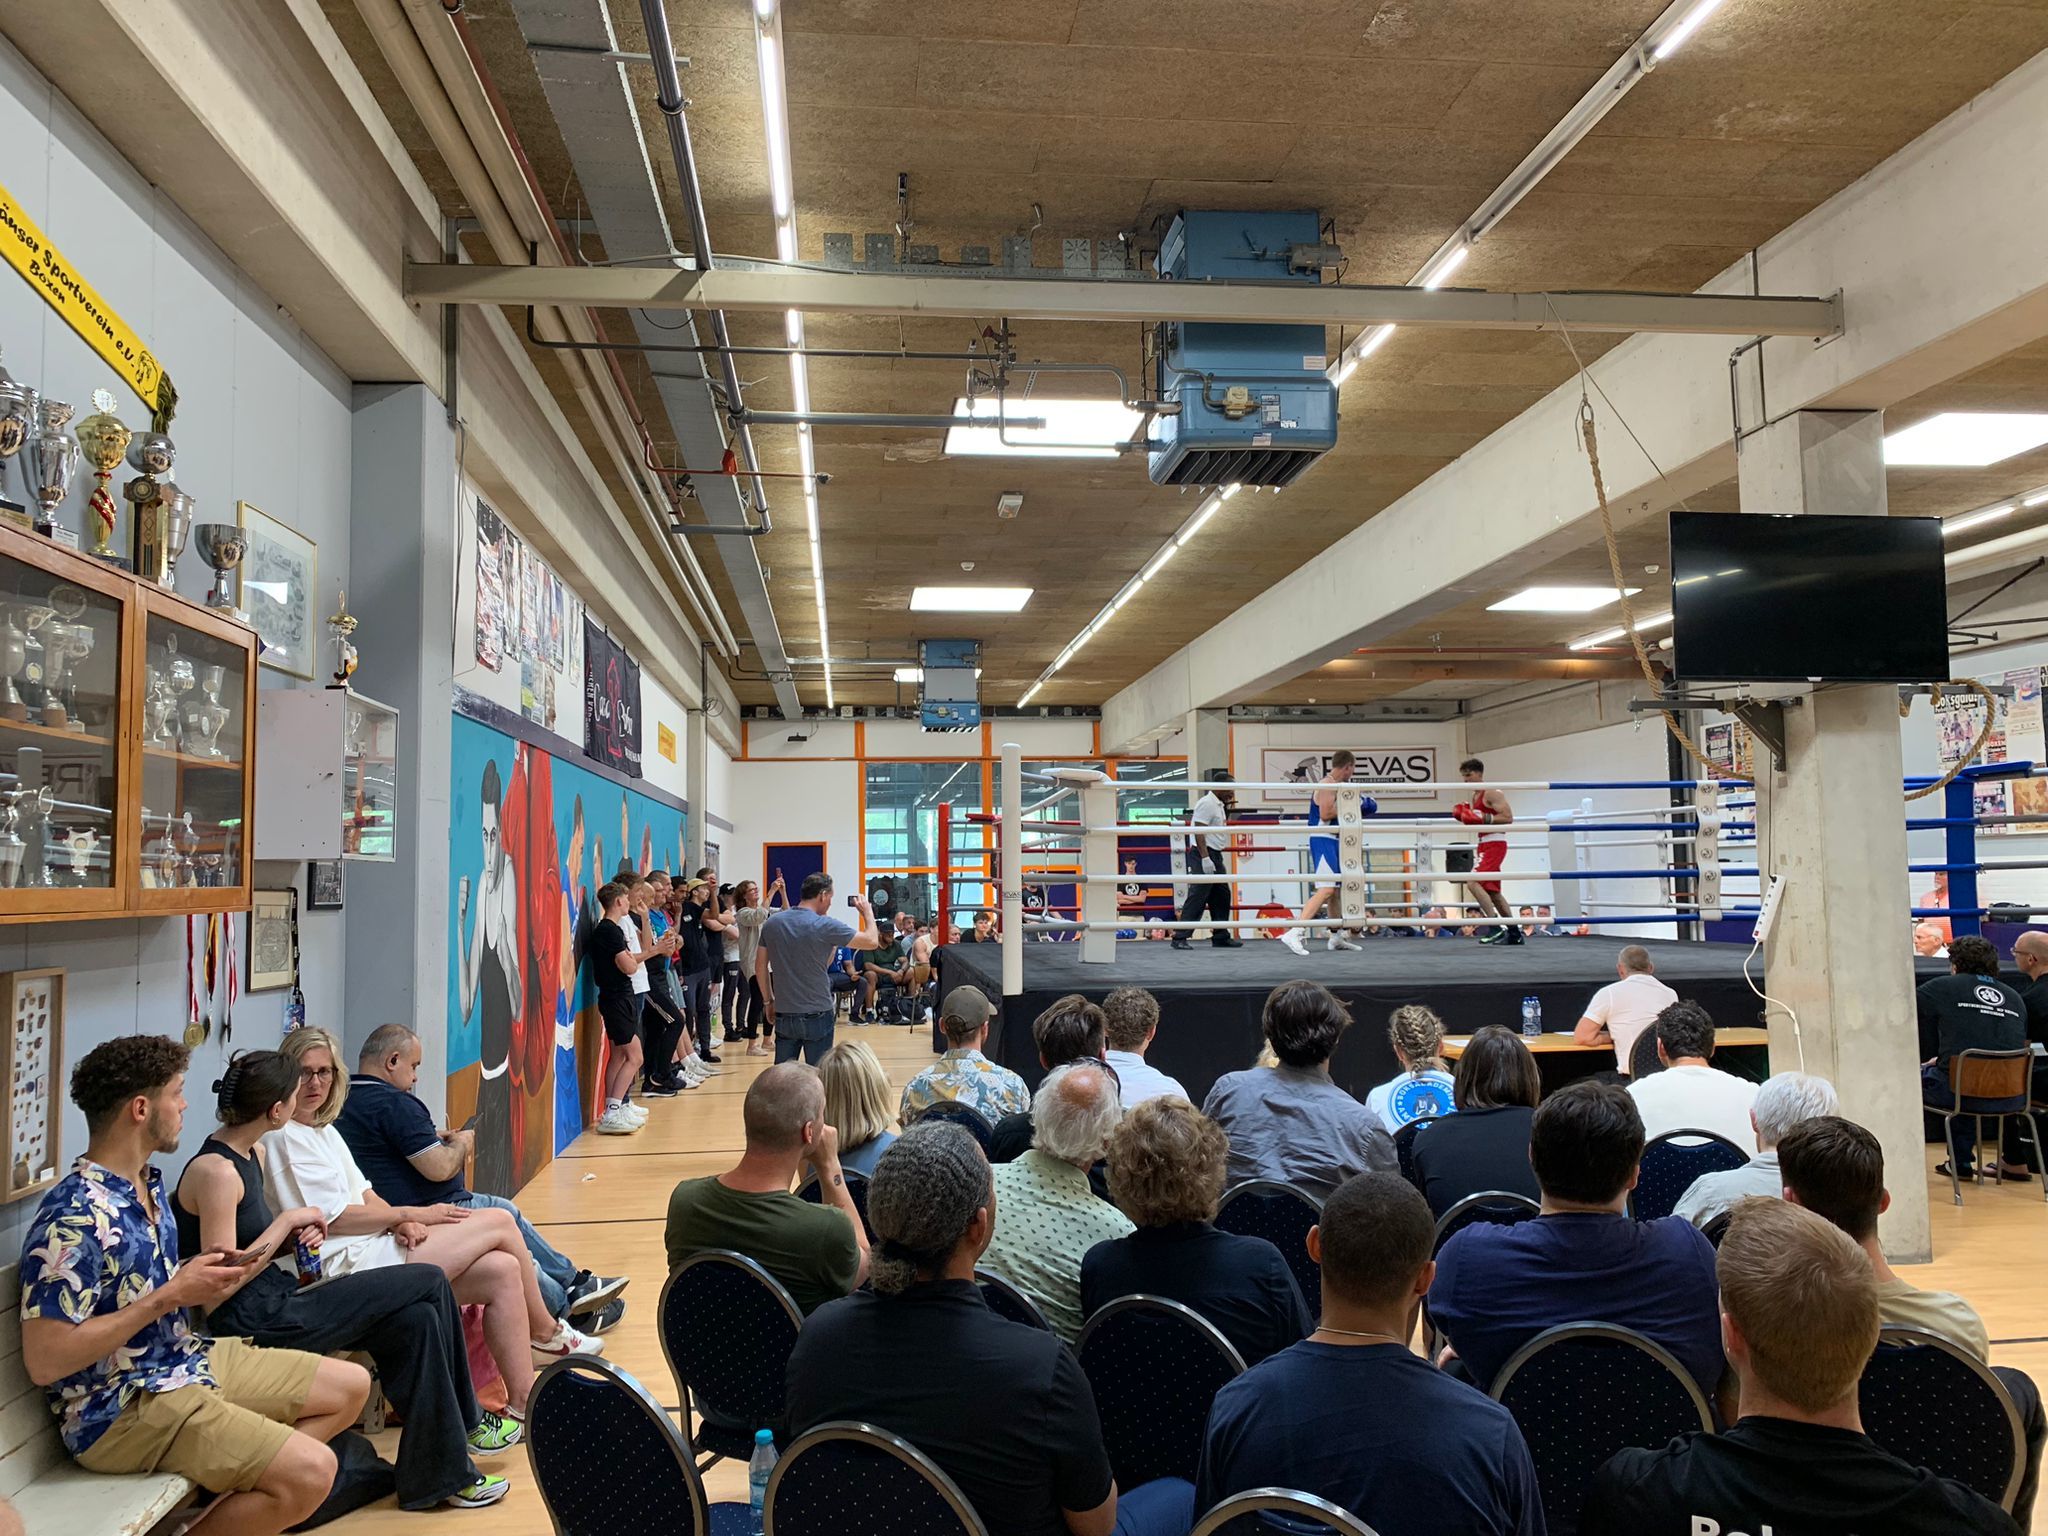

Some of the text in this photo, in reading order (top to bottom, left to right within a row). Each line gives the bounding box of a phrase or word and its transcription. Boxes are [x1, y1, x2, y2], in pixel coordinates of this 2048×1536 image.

[0, 202, 39, 253] änser
[43, 249, 113, 340] Sportverein
[29, 259, 65, 304] Boxen
